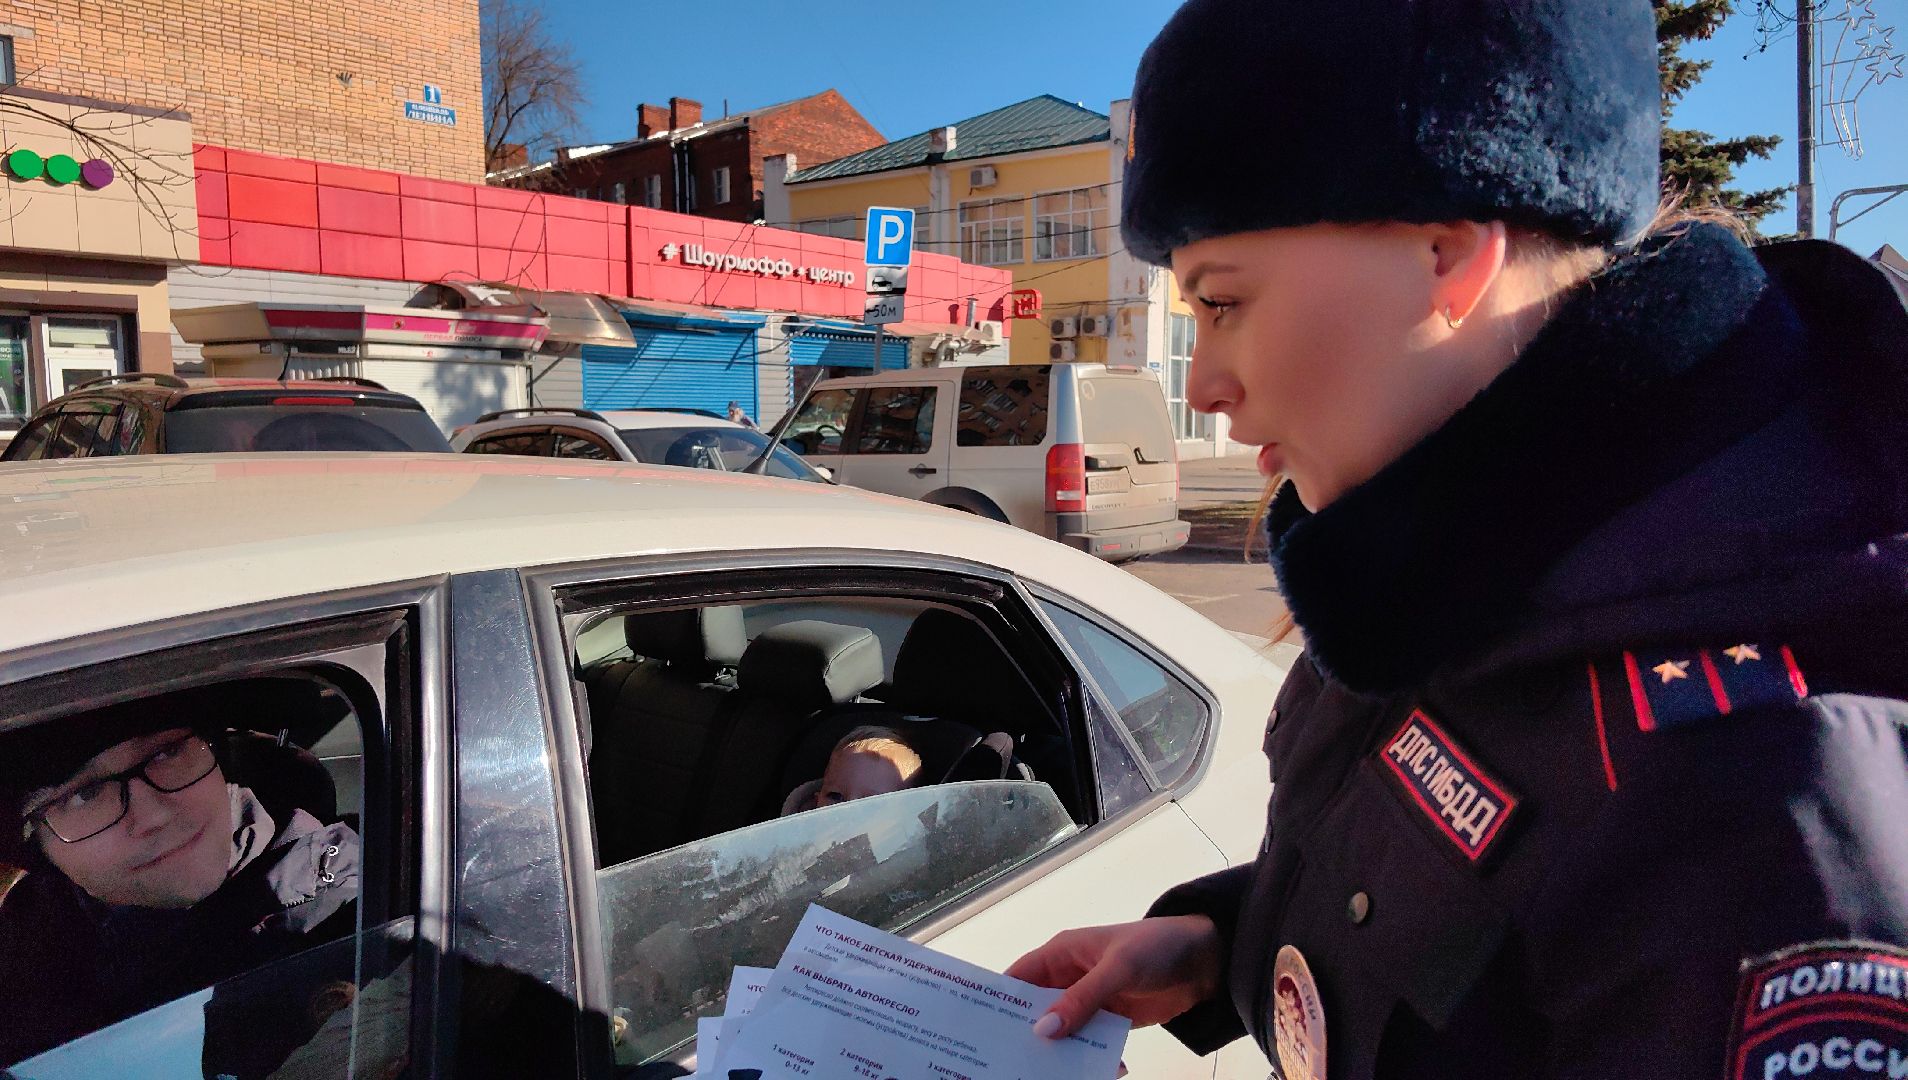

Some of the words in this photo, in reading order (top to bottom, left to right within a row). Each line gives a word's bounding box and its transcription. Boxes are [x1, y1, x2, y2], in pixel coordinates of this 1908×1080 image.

[427, 85, 437, 103] 1
[408, 110, 454, 126] ЛЕНИНА
[878, 215, 904, 259] P
[682, 243, 794, 278] Шаурмофф
[809, 265, 855, 286] центр
[1388, 725, 1439, 775] ДПС
[1421, 755, 1499, 847] ГИБДД
[814, 924, 833, 937] ЧТО
[834, 932, 861, 949] ТАКОЕ
[862, 943, 902, 963] ДЕТСКАЯ
[903, 957, 983, 992] УДЕРЖИВАЮЩАЯ
[983, 986, 1033, 1010] СИСТЕМА?
[793, 964, 811, 977] КАК
[812, 969, 854, 993] ВЫБРАТЬ
[854, 988, 920, 1017] АВТОКРЕСЛО?
[1760, 961, 1908, 1010] ПОЛИЦ
[778, 1047, 815, 1066] категория
[784, 1060, 801, 1072] 0-13
[801, 1068, 811, 1076] кг
[846, 1051, 883, 1071] категория
[853, 1064, 871, 1077] 9-18
